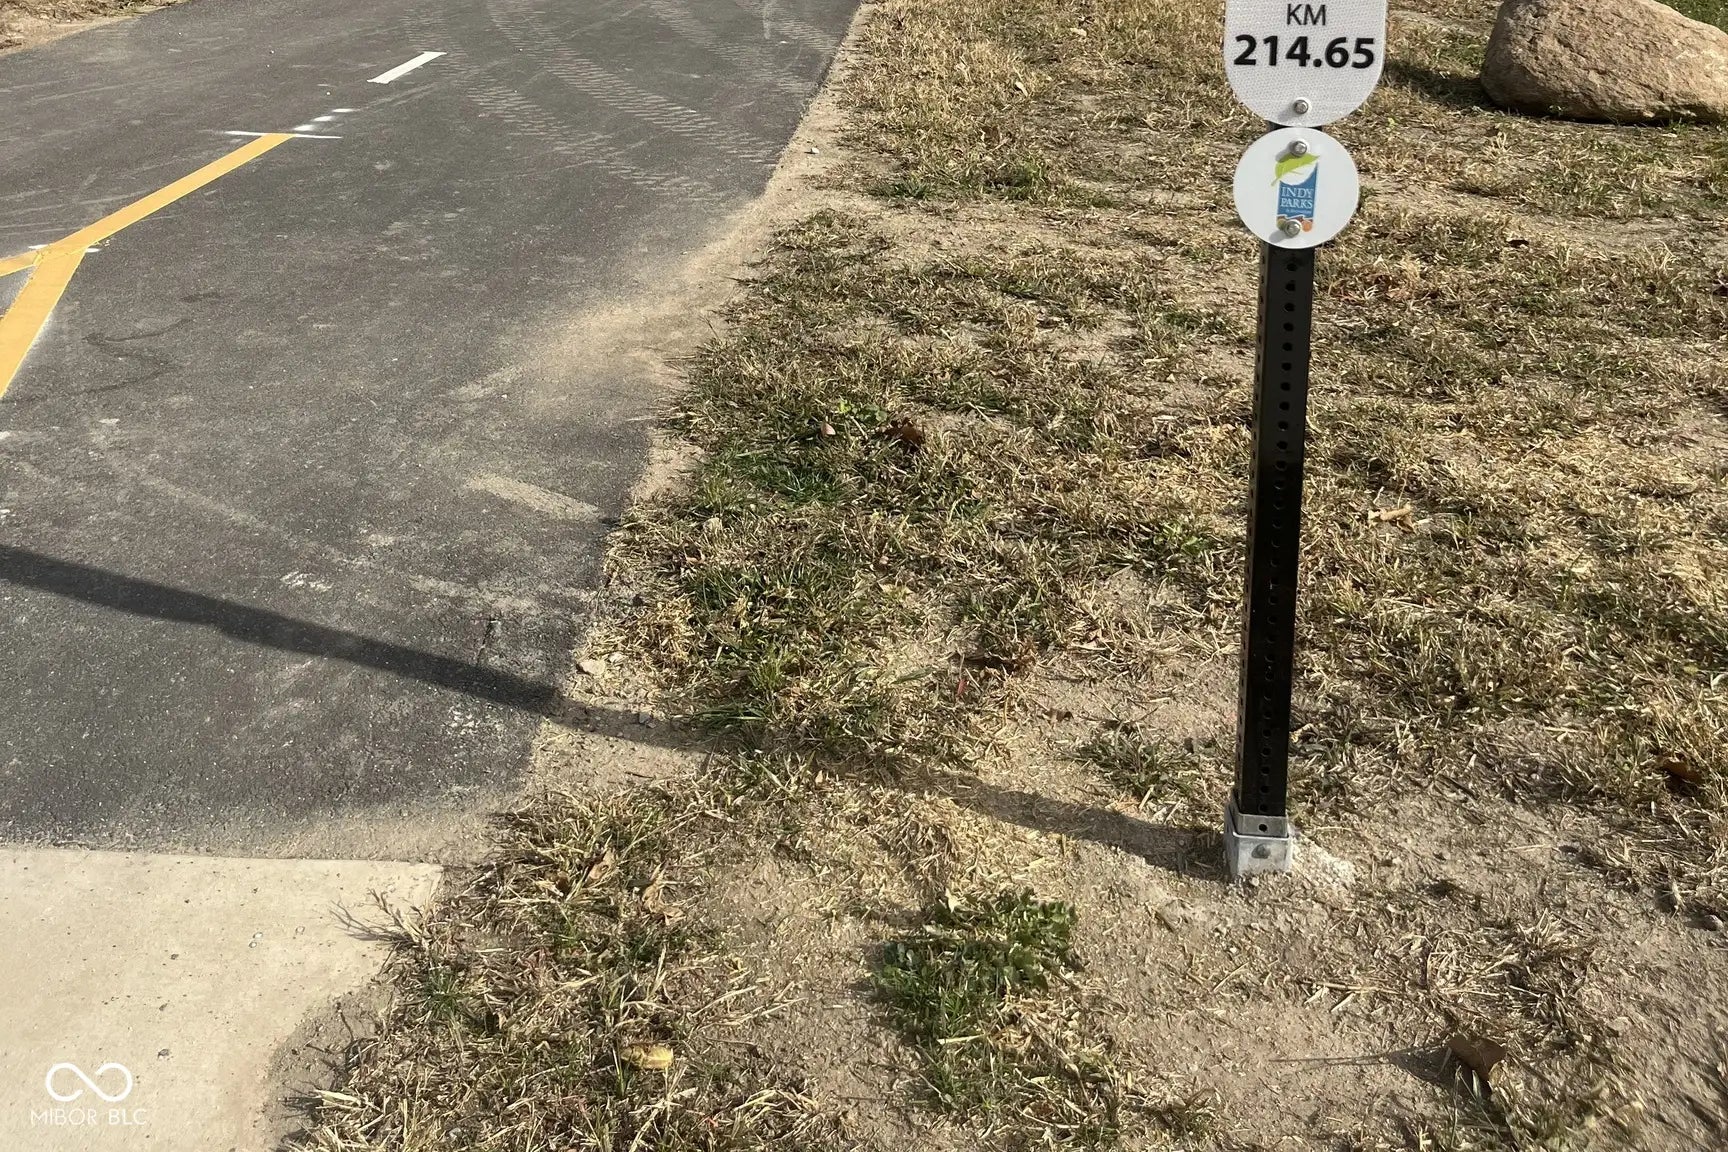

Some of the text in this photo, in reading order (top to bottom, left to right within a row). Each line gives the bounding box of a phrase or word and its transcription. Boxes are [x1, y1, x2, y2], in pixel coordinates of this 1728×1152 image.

[1286, 3, 1327, 26] KM
[1233, 34, 1375, 69] 214.65
[1281, 186, 1314, 198] INDY
[1280, 197, 1313, 209] PARKS
